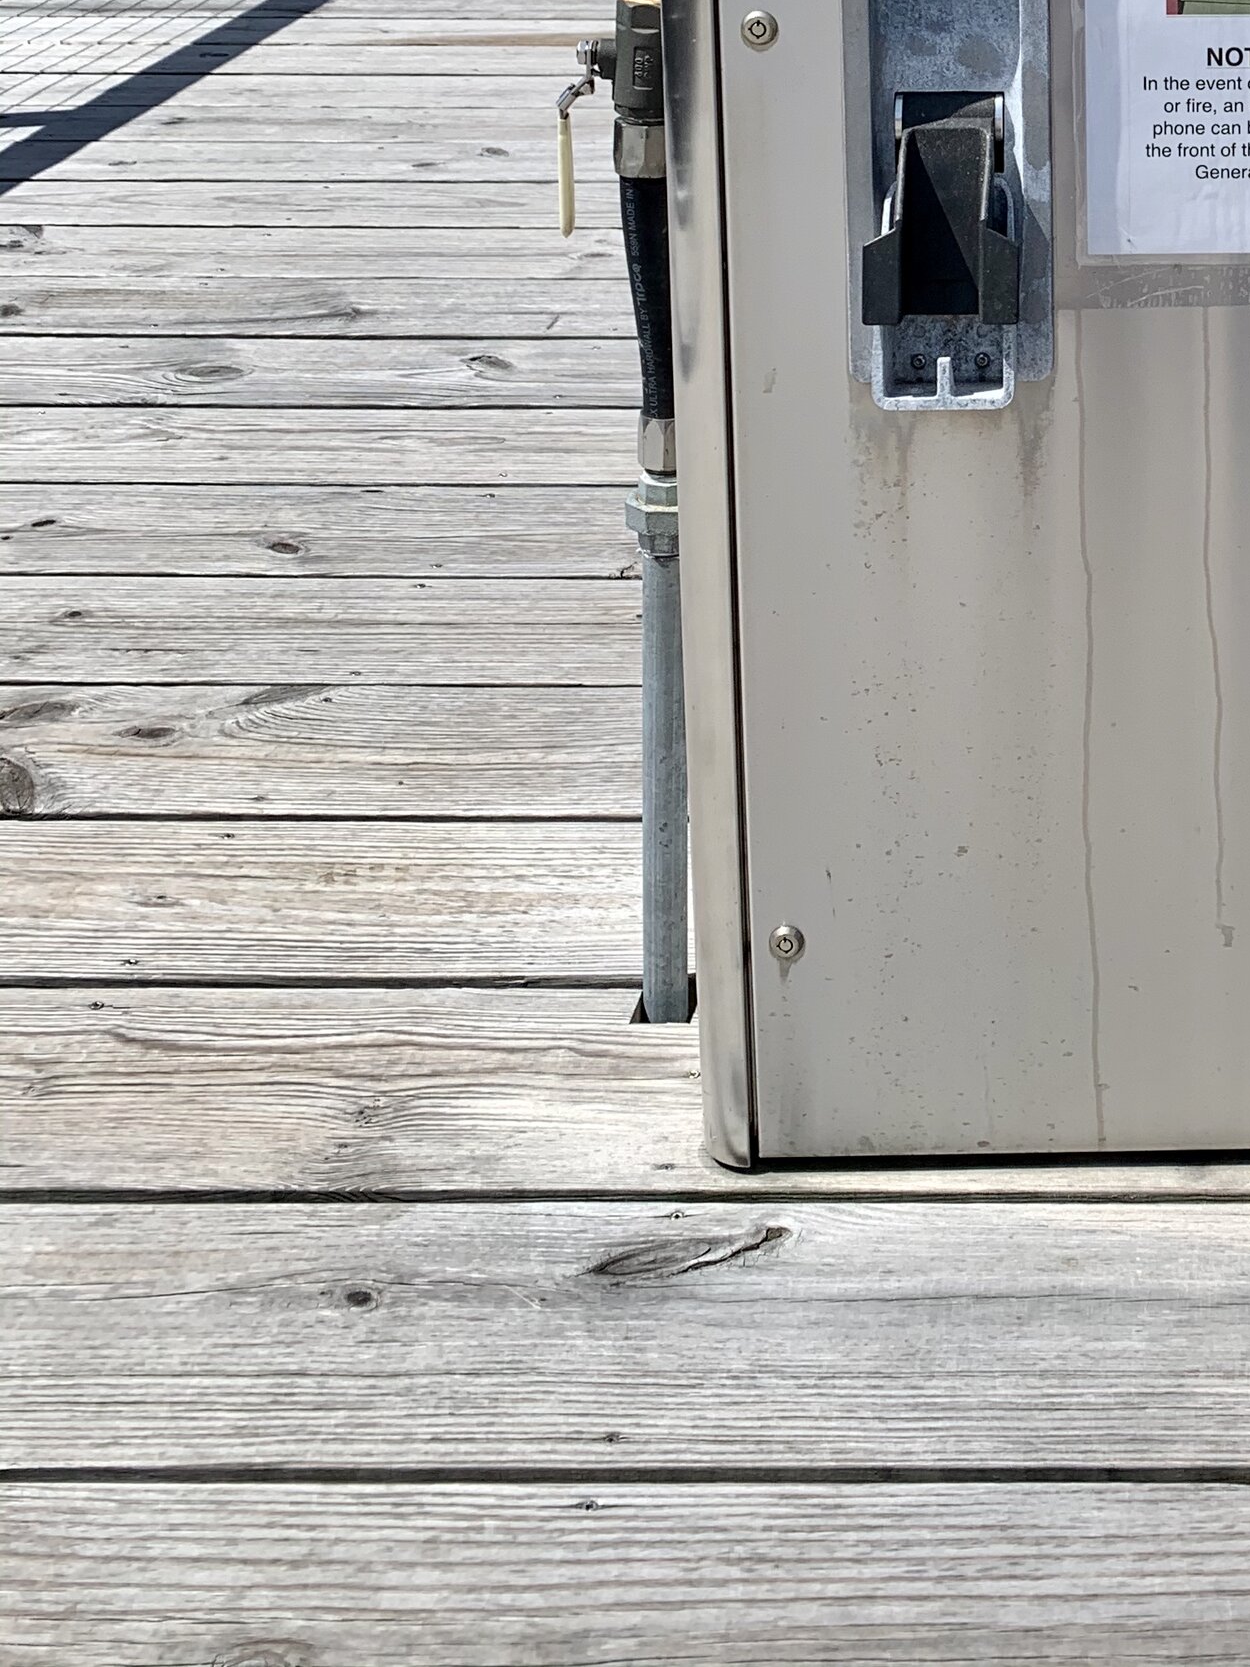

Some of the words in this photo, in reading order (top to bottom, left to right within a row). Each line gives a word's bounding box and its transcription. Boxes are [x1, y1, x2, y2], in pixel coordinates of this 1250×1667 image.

[1142, 76, 1158, 91] In
[1163, 76, 1190, 91] the
[1195, 77, 1242, 91] event
[1164, 102, 1181, 113] or
[1185, 99, 1217, 116] fire,
[1223, 102, 1245, 113] an
[1152, 120, 1205, 138] phone
[1210, 124, 1241, 135] can
[1146, 143, 1172, 157] the
[1177, 142, 1216, 157] front
[1220, 142, 1236, 157] of
[626, 188, 635, 200] IN
[626, 202, 636, 231] MADE
[640, 308, 650, 321] BY
[642, 321, 656, 374] HARDWALL
[646, 376, 658, 407] ULTRA
